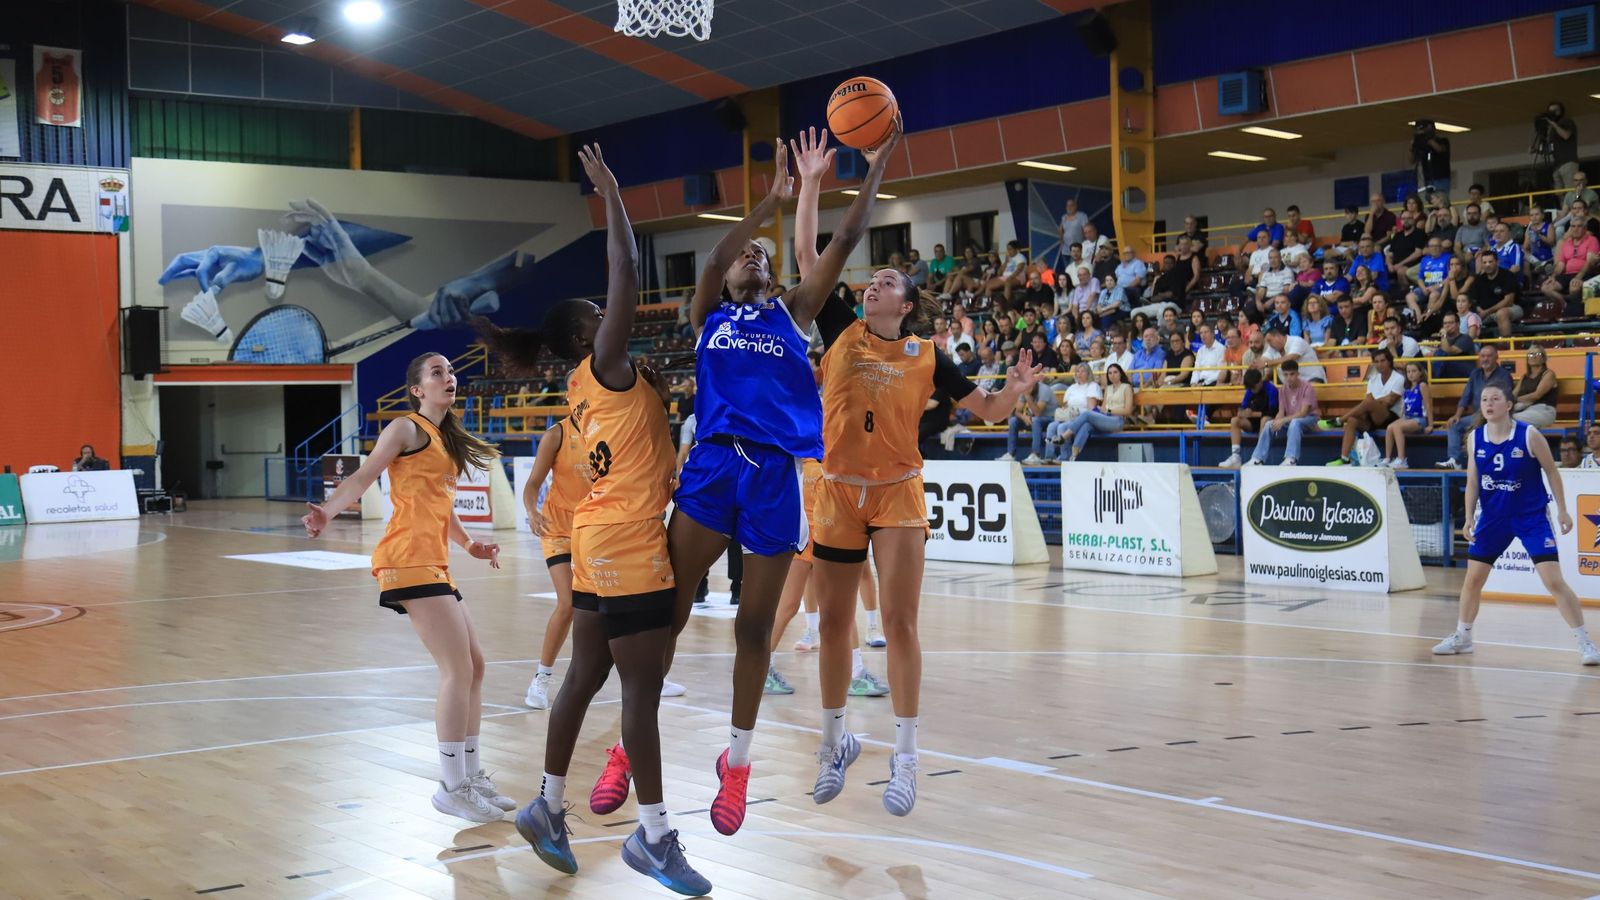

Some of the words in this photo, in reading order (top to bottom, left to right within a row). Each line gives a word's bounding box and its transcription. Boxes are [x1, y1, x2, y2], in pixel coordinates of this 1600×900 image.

[862, 371, 893, 385] salud
[864, 410, 875, 433] 8
[1493, 453, 1505, 471] 9
[46, 504, 92, 514] recoletas
[94, 502, 119, 511] salud
[1259, 495, 1315, 527] Paulino
[1321, 496, 1375, 530] Iglesias
[978, 534, 1008, 543] CRUCES
[1068, 533, 1146, 552] HERBI-PLAST,
[1150, 538, 1172, 552] S.L.
[1279, 531, 1313, 540] Embutidos
[1313, 534, 1319, 542] y
[1319, 533, 1348, 542] Jamones
[1069, 550, 1172, 566] SEÑALIZACIONES
[1250, 563, 1384, 583] www.paulinoiglesias.com
